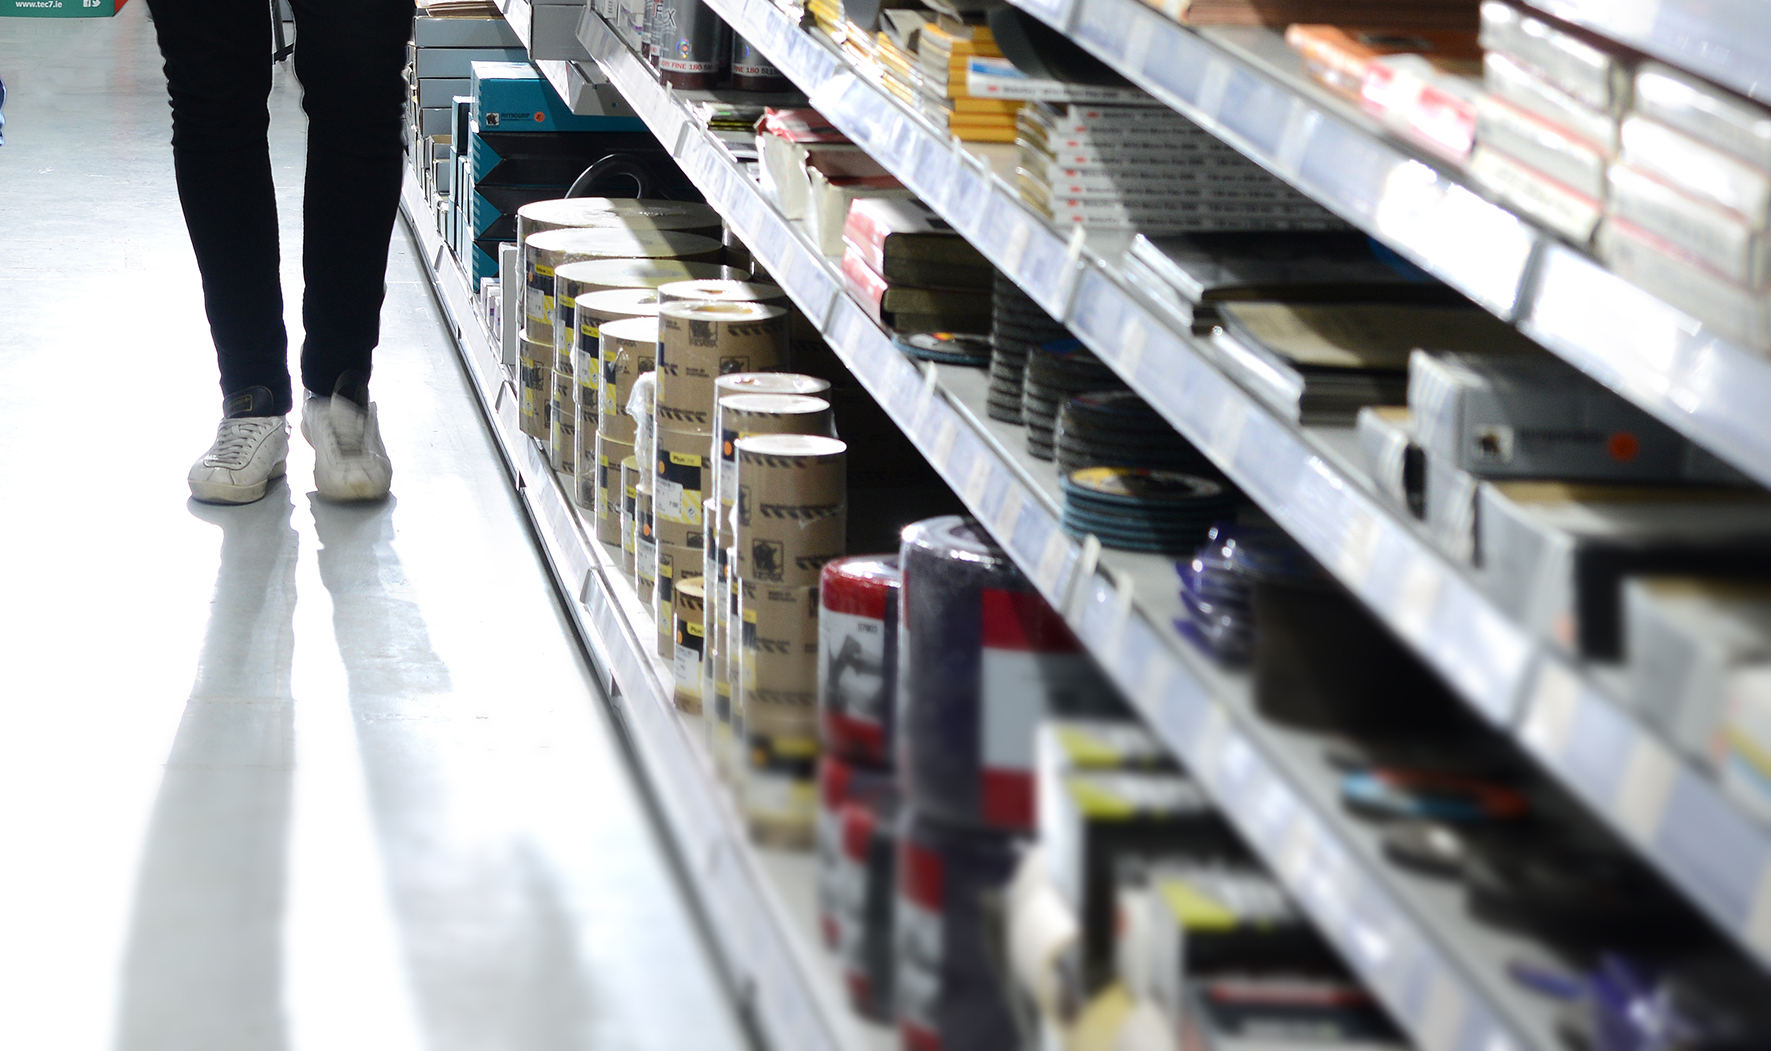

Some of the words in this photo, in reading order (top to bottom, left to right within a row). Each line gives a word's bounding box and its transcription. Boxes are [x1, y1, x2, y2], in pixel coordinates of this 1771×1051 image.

[15, 0, 63, 8] www.tec7.ie
[672, 62, 686, 70] FINE
[746, 66, 760, 74] 180
